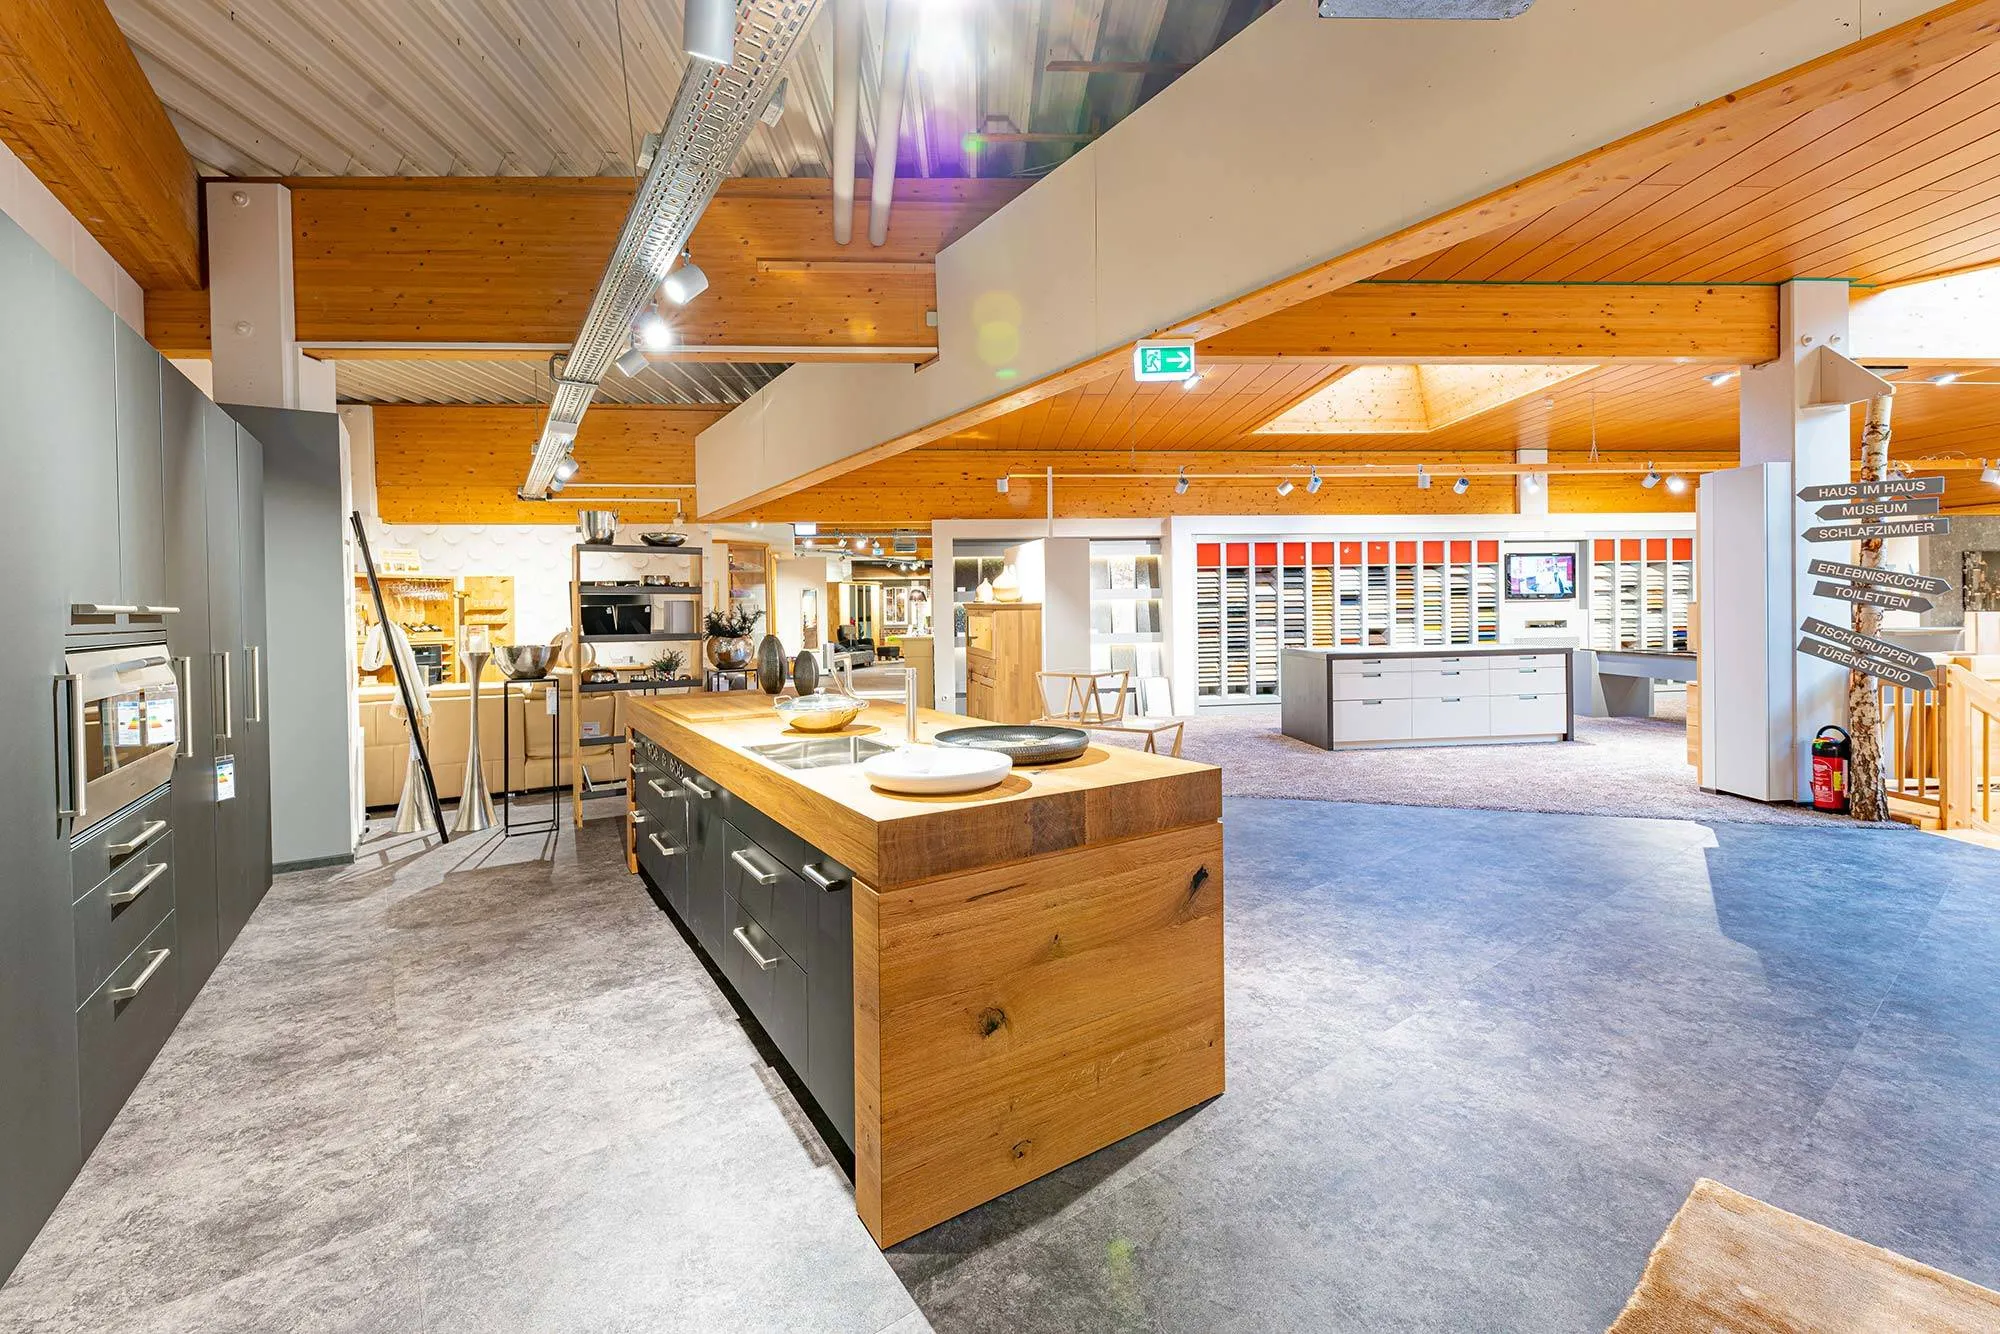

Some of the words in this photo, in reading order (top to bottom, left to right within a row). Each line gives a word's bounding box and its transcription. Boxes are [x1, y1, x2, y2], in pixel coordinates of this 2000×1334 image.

[1819, 486, 1858, 498] HAUS
[1863, 485, 1880, 495] IM
[1884, 481, 1926, 493] HAUS
[1842, 503, 1908, 516] MUSEUM
[1819, 522, 1935, 539] SCHLAFZIMMER
[1817, 563, 1936, 591] ERLEBNISKÜCHE
[1835, 586, 1911, 608] TOILETTEN
[1815, 622, 1919, 666] TISCHGRUPPEN
[1817, 644, 1911, 682] TÜRENSTUDIO
